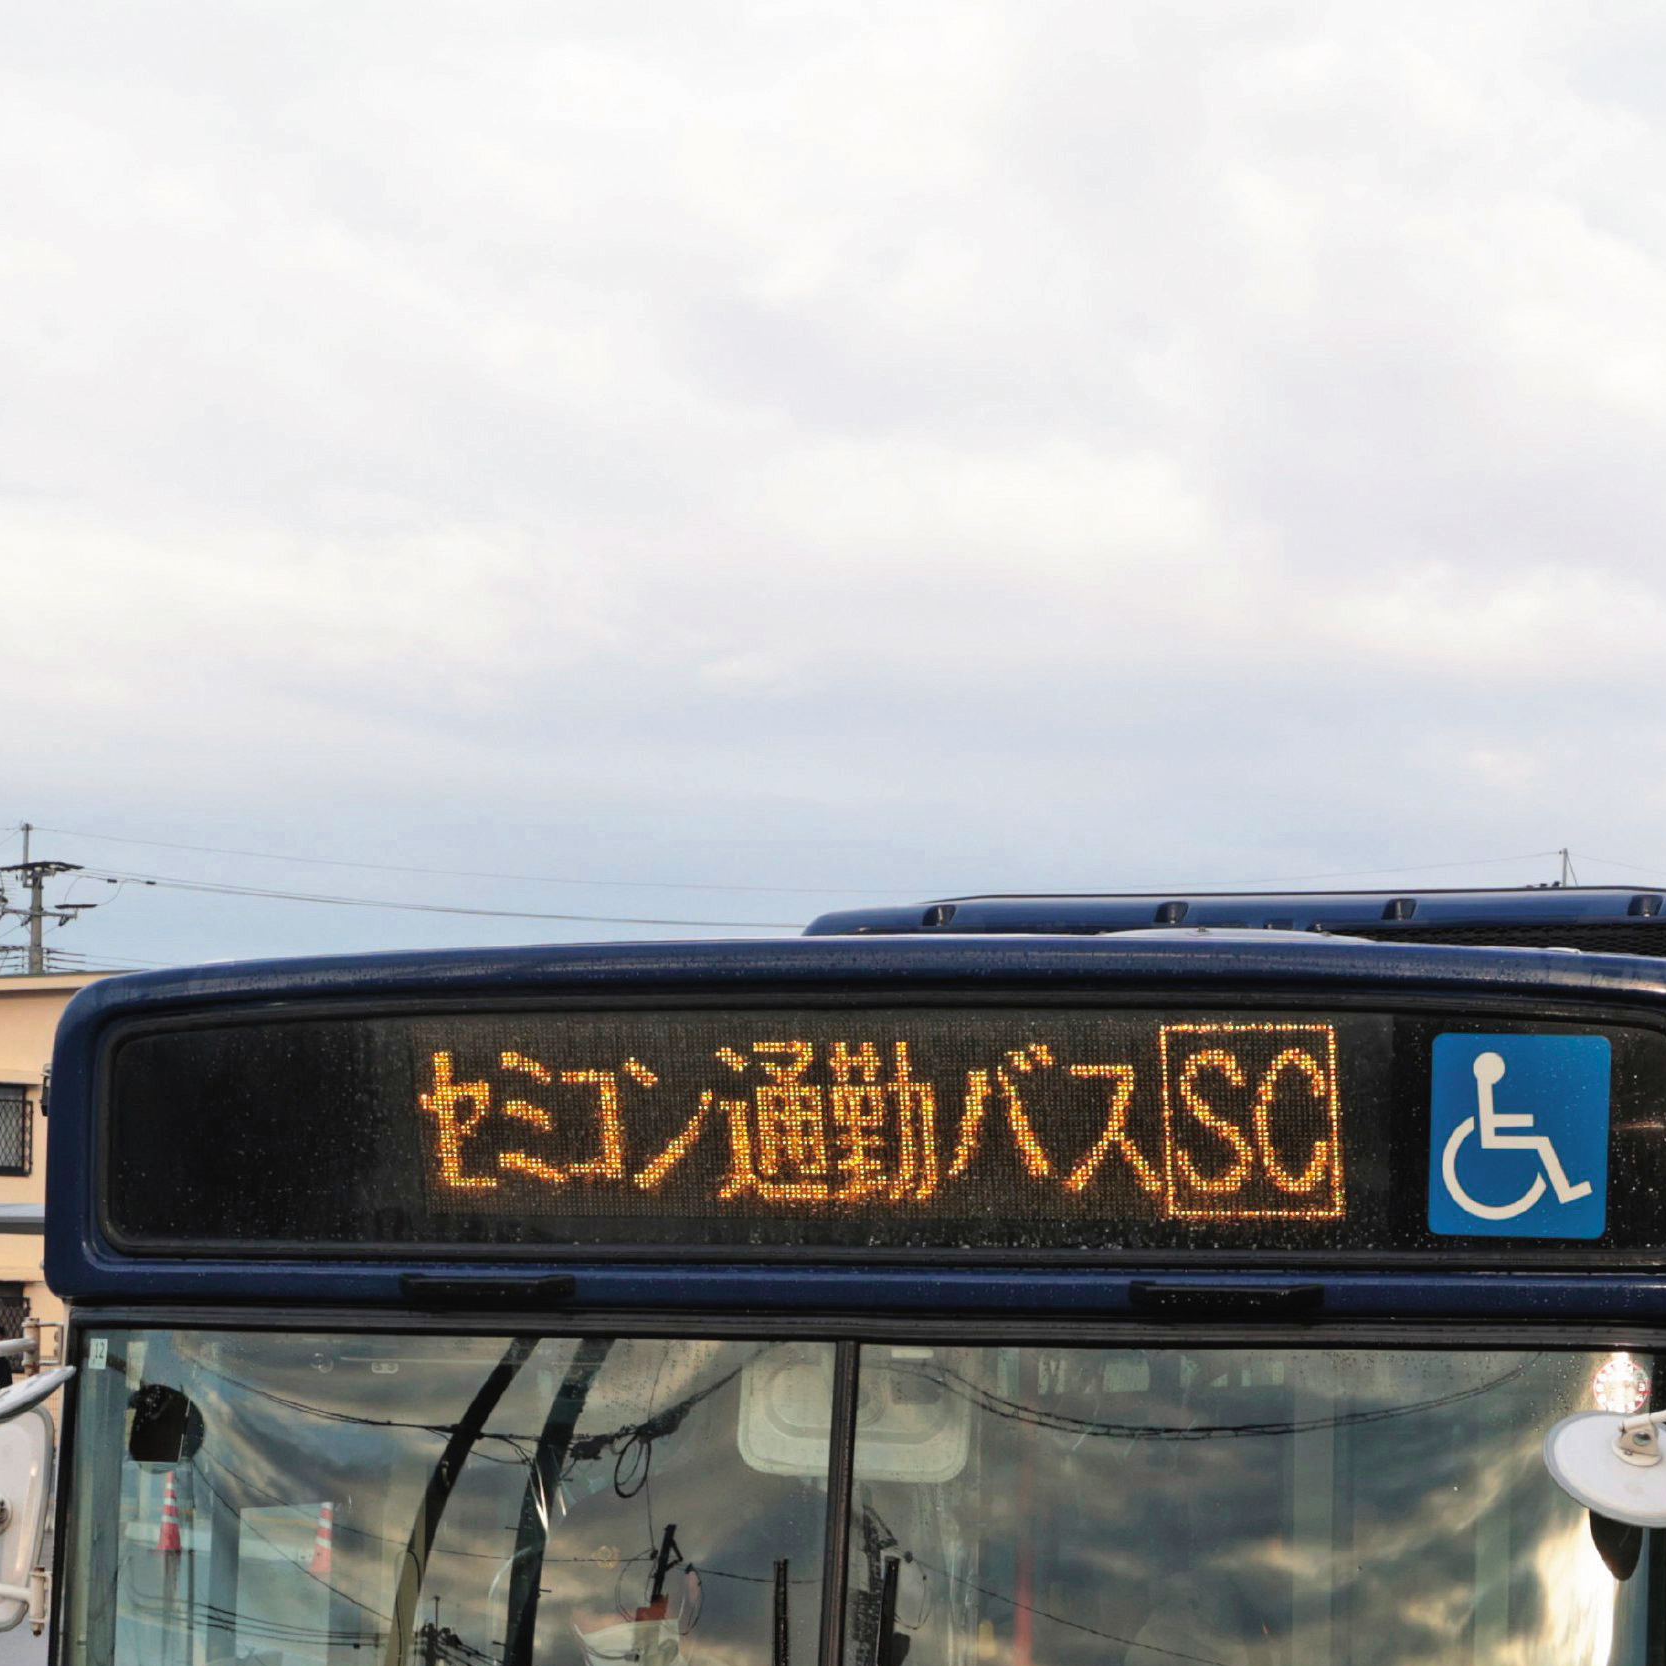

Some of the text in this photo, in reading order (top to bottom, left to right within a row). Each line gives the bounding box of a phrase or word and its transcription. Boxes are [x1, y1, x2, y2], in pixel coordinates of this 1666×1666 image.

[420, 1040, 1162, 1201] セミコン通勤バス
